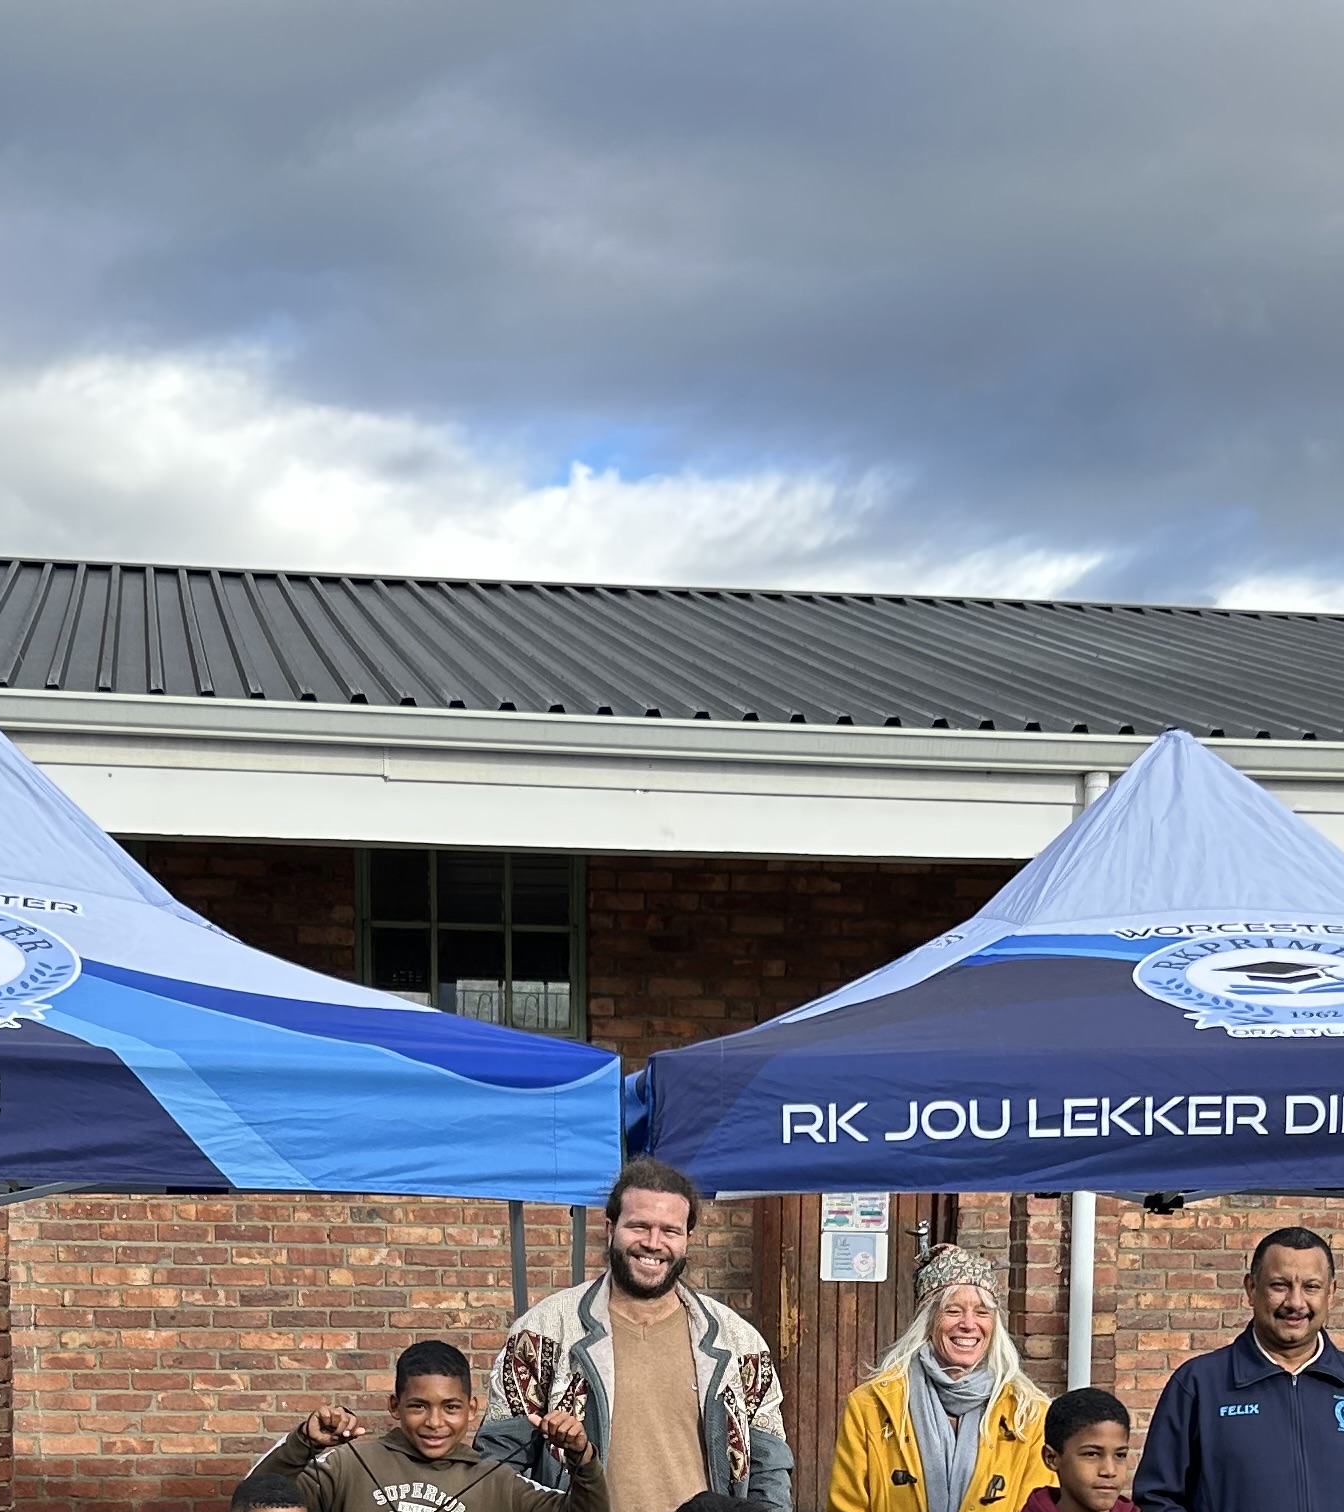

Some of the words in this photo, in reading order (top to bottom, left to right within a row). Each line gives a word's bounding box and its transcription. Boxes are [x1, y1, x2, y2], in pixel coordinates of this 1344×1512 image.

[1290, 1010, 1343, 1019] 1962
[782, 1102, 869, 1143] RK
[885, 1099, 1011, 1142] JOU
[1028, 1096, 1269, 1139] LEKKER
[1219, 1404, 1260, 1417] FELIX
